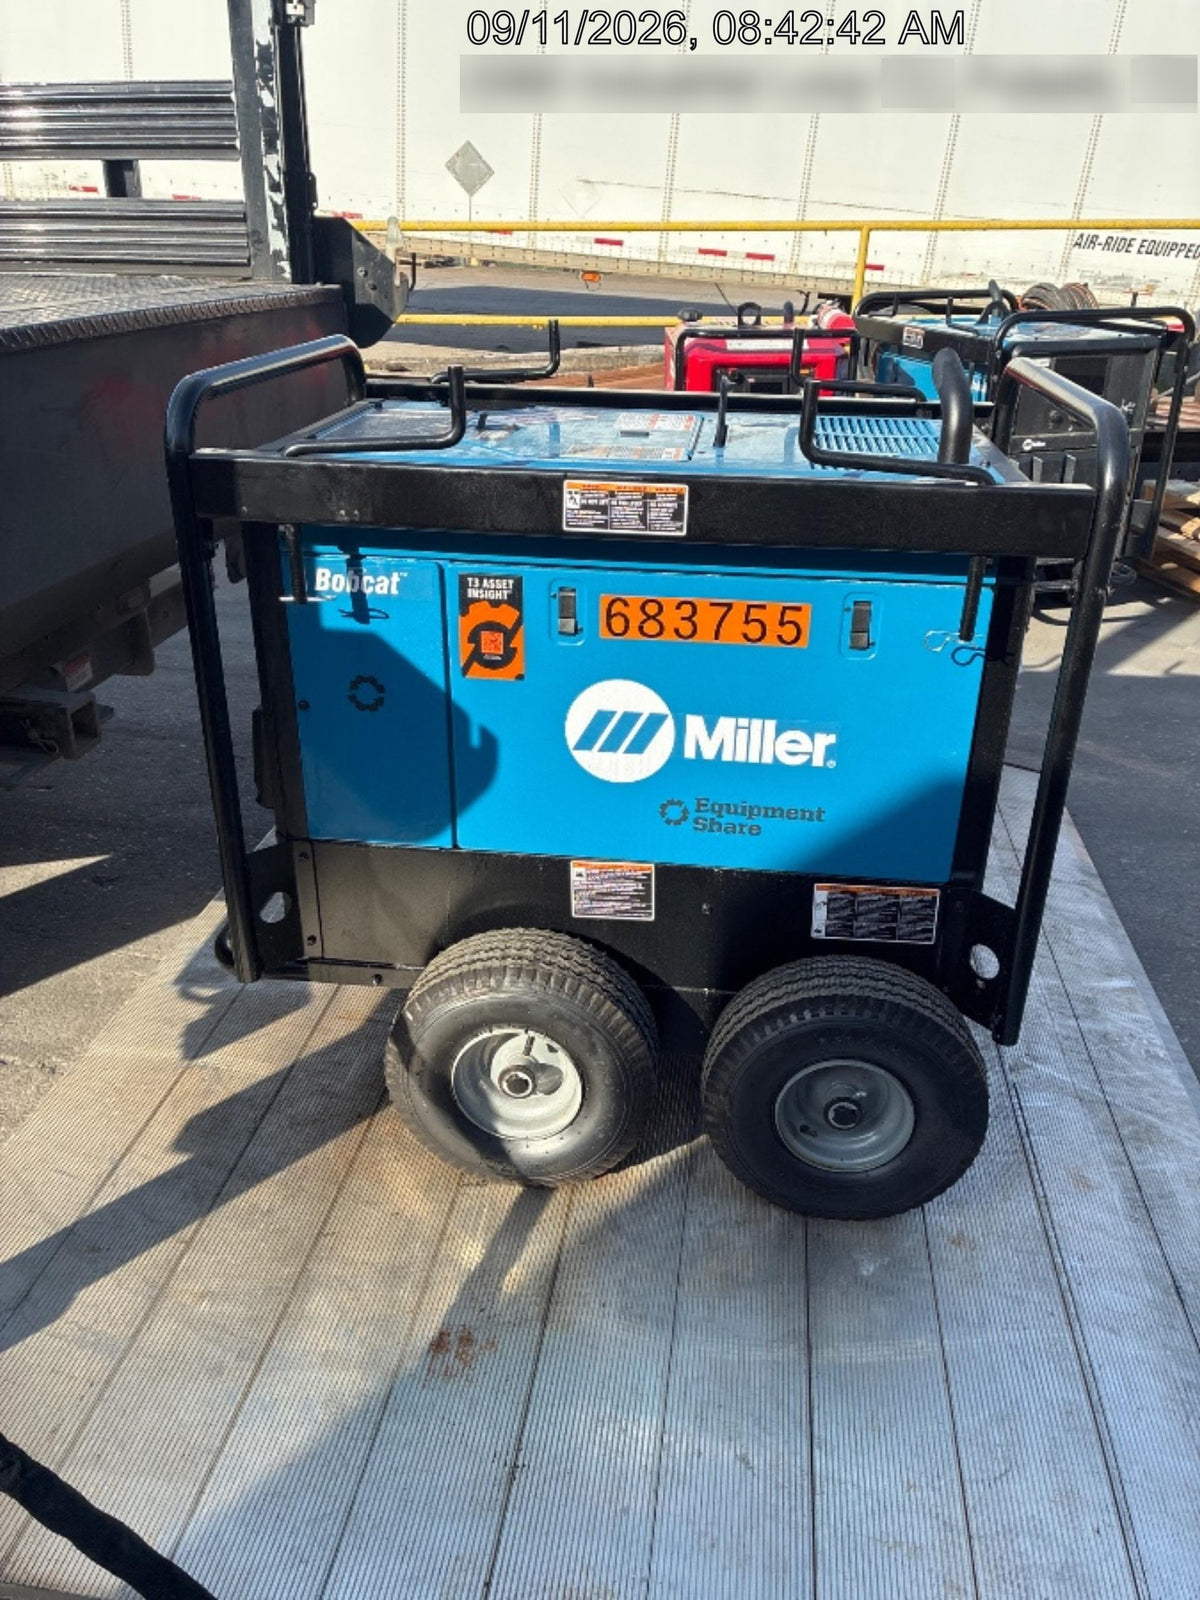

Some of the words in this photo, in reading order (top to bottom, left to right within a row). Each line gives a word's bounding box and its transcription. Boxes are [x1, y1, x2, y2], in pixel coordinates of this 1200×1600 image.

[1073, 232, 1136, 253] AIR-RIDE
[315, 568, 400, 595] Bobcat
[467, 577, 480, 588] T3
[482, 578, 514, 589] ASSET
[467, 588, 509, 600] INSIGHT
[605, 597, 803, 646] 683755
[683, 713, 837, 768] Miller
[694, 797, 826, 822] Equipment
[693, 817, 763, 837] Share
